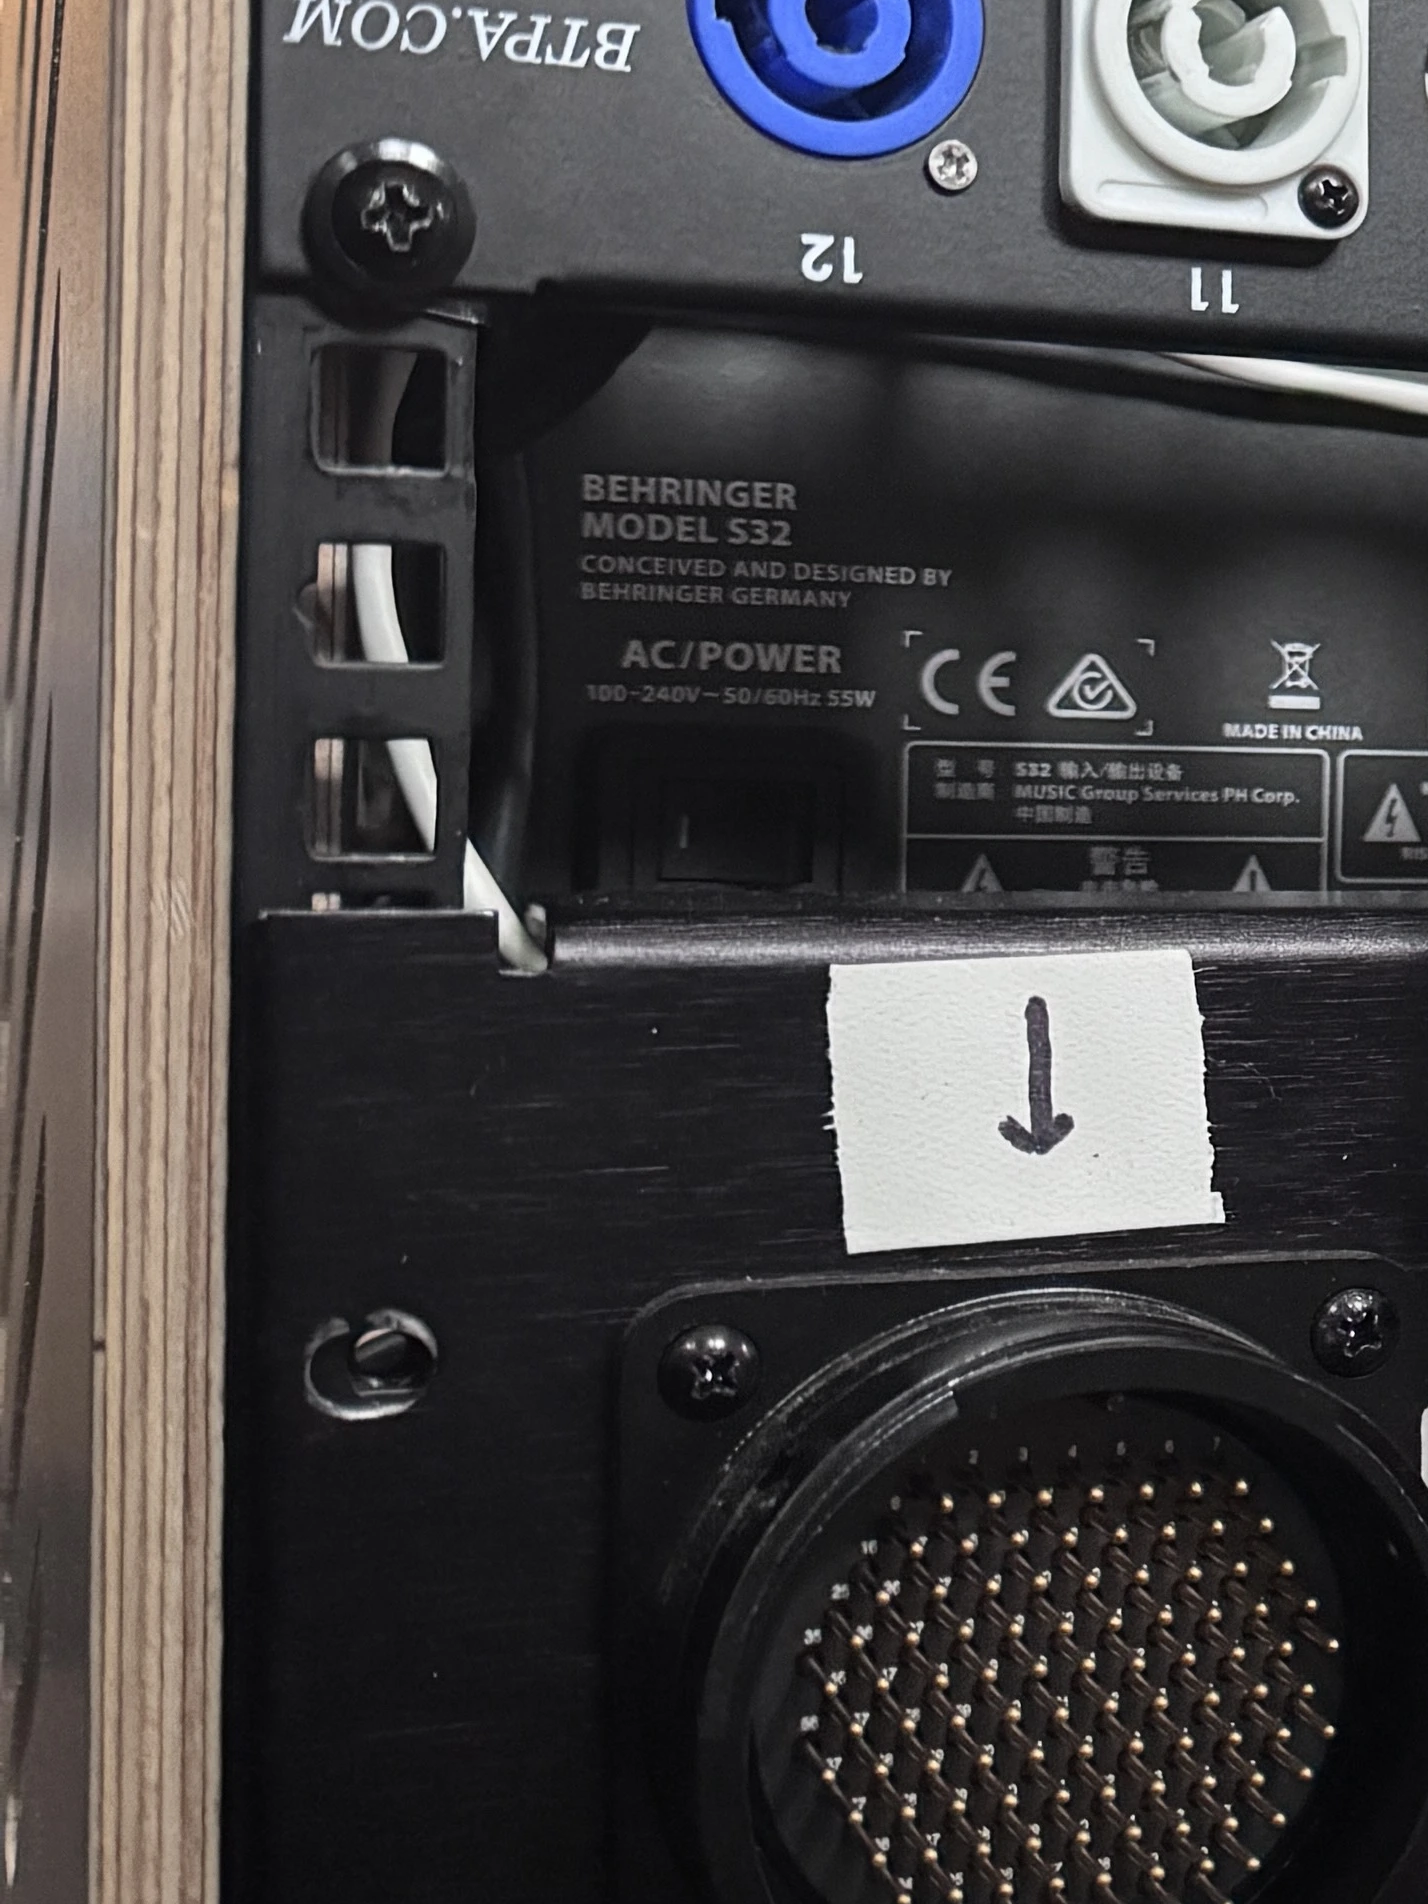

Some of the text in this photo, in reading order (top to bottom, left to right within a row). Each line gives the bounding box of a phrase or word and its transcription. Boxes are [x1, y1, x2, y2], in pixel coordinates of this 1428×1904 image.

[799, 232, 865, 286] 12
[1188, 266, 1242, 315] 11
[580, 473, 798, 511] BEHRINGER
[580, 511, 794, 547] MODEL S32
[580, 554, 953, 588] CONCEIVED AND DESIGNED BY
[580, 581, 852, 609] BEHRINGER GERMANY
[620, 638, 843, 675] AC/POWER
[920, 648, 1017, 717] CE
[1223, 722, 1364, 743] MADE IN CHINA
[1014, 785, 1301, 807] MUSIC Group Services PH Corp.
